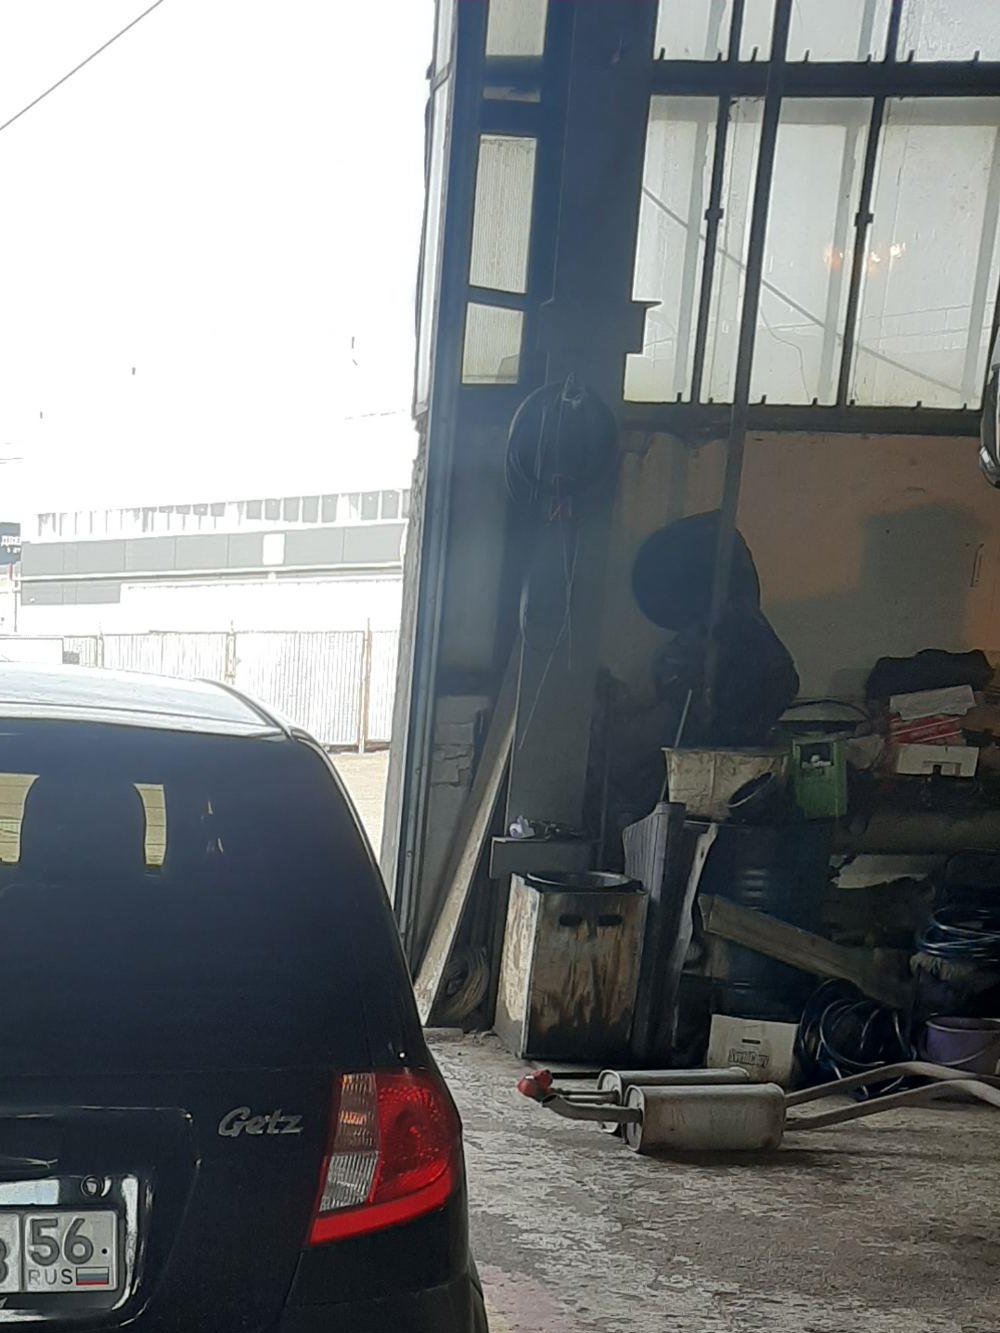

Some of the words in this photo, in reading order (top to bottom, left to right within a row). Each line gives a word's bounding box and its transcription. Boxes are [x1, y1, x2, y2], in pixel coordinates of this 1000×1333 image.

[218, 1106, 304, 1137] Getz
[30, 1218, 94, 1267] 56
[28, 1268, 73, 1285] RUS
